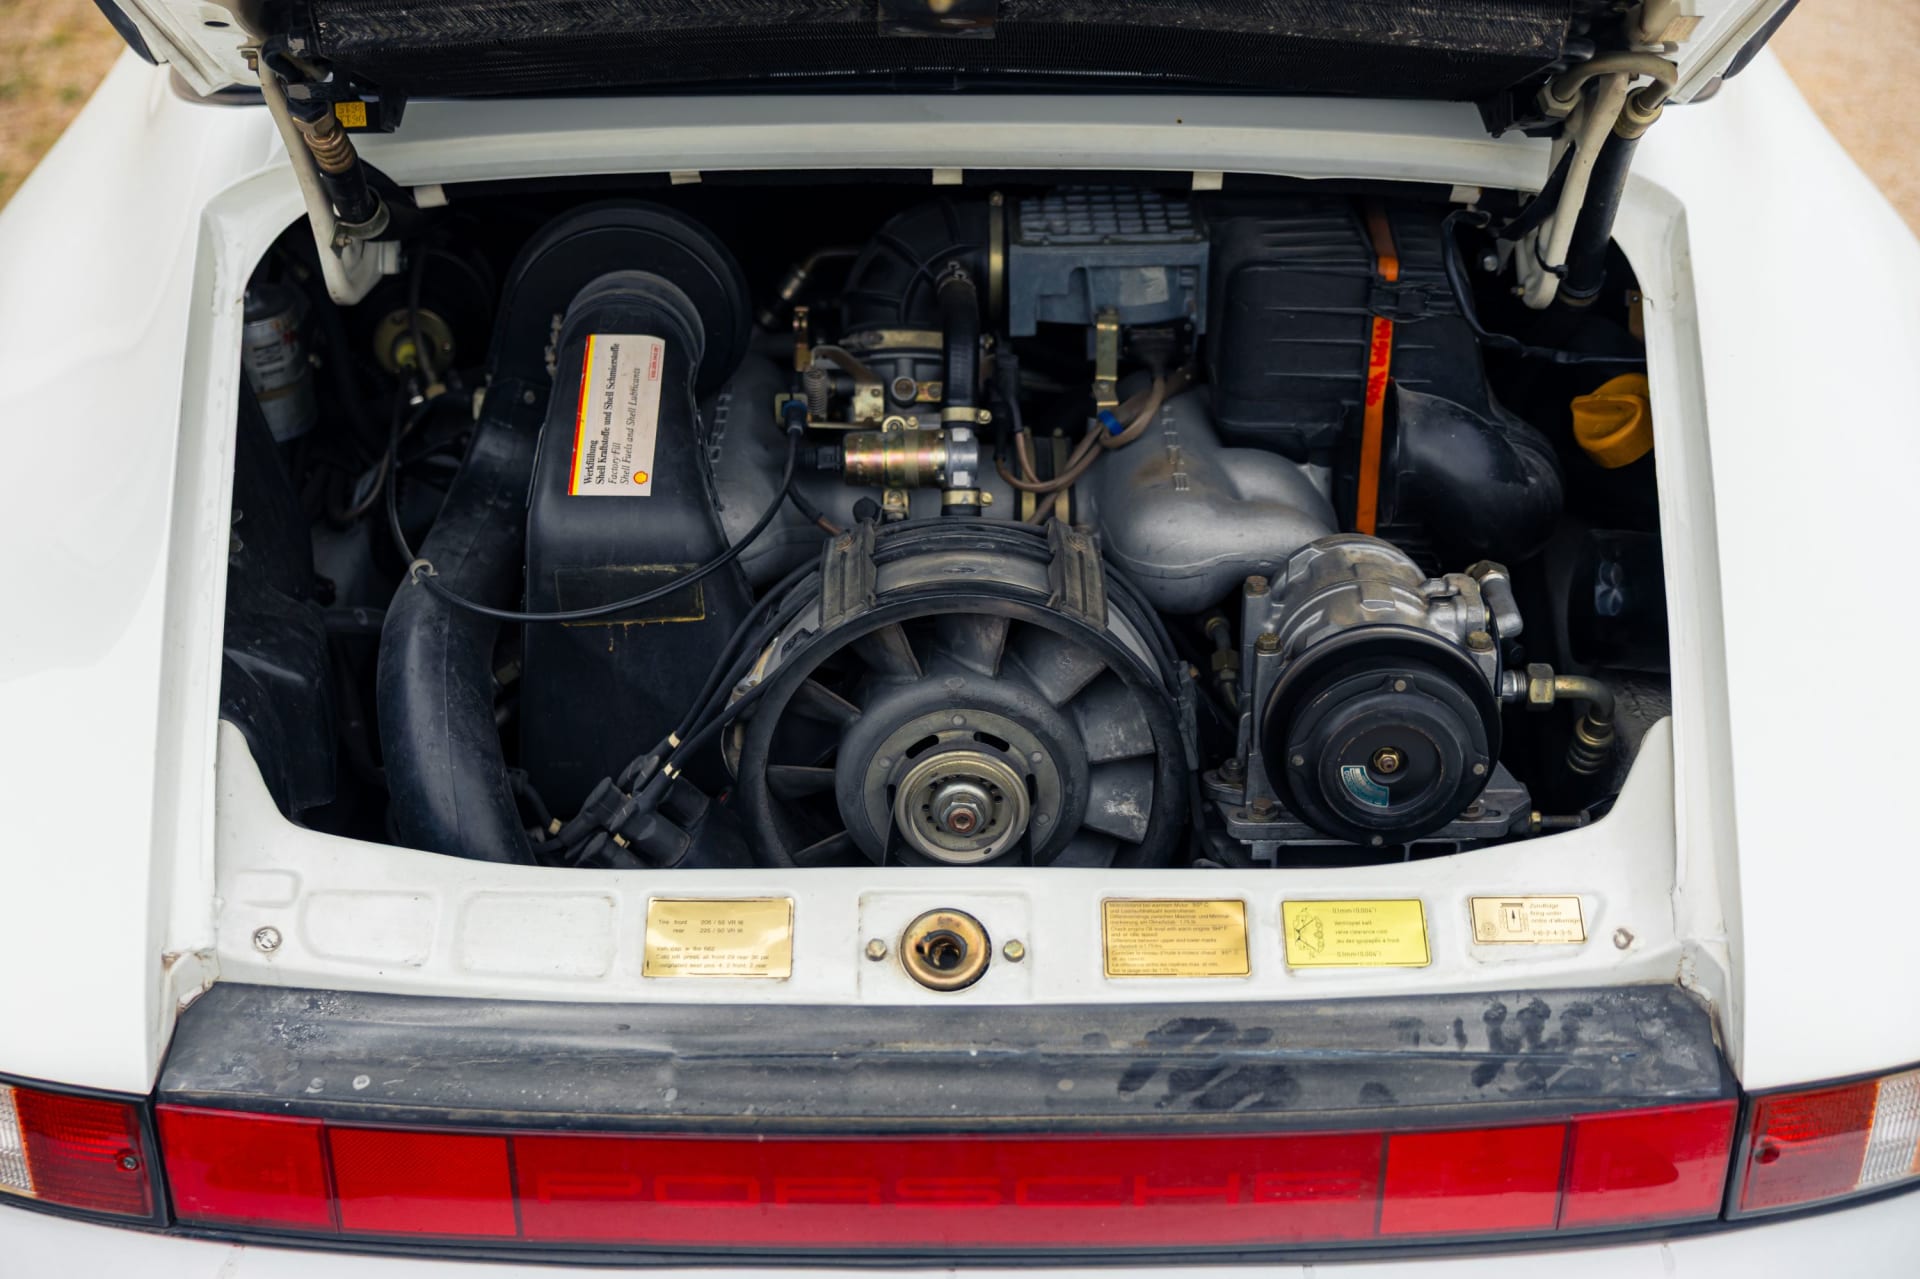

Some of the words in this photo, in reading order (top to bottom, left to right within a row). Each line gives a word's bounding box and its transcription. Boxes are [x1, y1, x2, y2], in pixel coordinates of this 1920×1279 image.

[606, 344, 620, 390] Schmierstoffe
[628, 368, 640, 406] Lubricants
[604, 392, 614, 410] Shell
[602, 412, 612, 426] und
[626, 408, 636, 426] Shell
[626, 428, 634, 442] and
[598, 427, 610, 463] Kraftstoffe
[611, 442, 622, 455] Fill
[622, 444, 632, 464] Fuels
[584, 440, 598, 484] Werkfüllung
[608, 456, 620, 484] Factory
[596, 466, 607, 485] Shell
[620, 466, 630, 484] Shell
[536, 1170, 1362, 1207] PORSCHE
